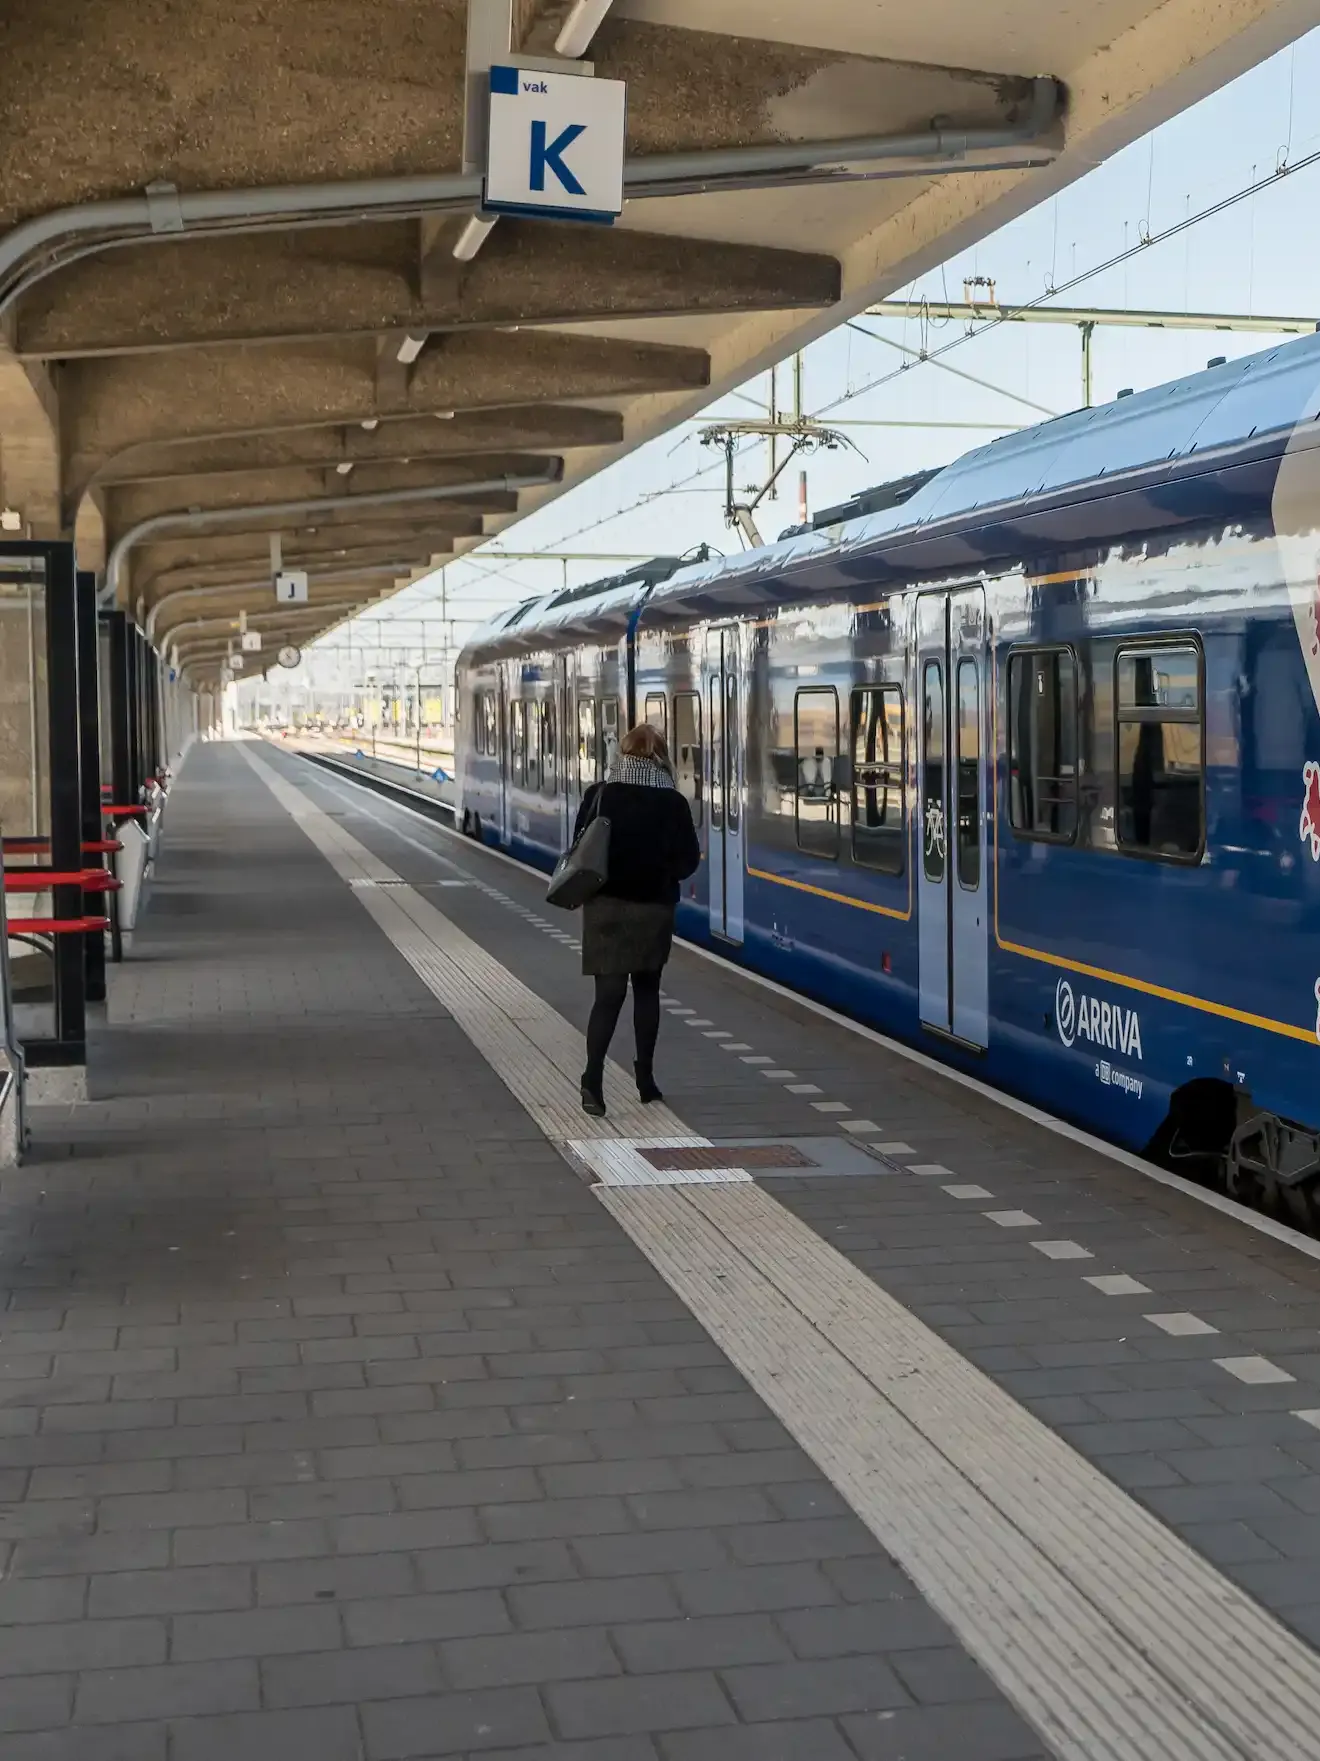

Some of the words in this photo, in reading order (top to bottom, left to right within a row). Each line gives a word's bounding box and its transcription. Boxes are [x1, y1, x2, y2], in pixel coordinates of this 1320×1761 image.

[522, 81, 548, 94] vak
[529, 120, 588, 195] K
[287, 582, 296, 598] J
[1077, 994, 1143, 1060] ARRIVA
[1095, 1063, 1099, 1077] a
[1111, 1070, 1143, 1100] company
